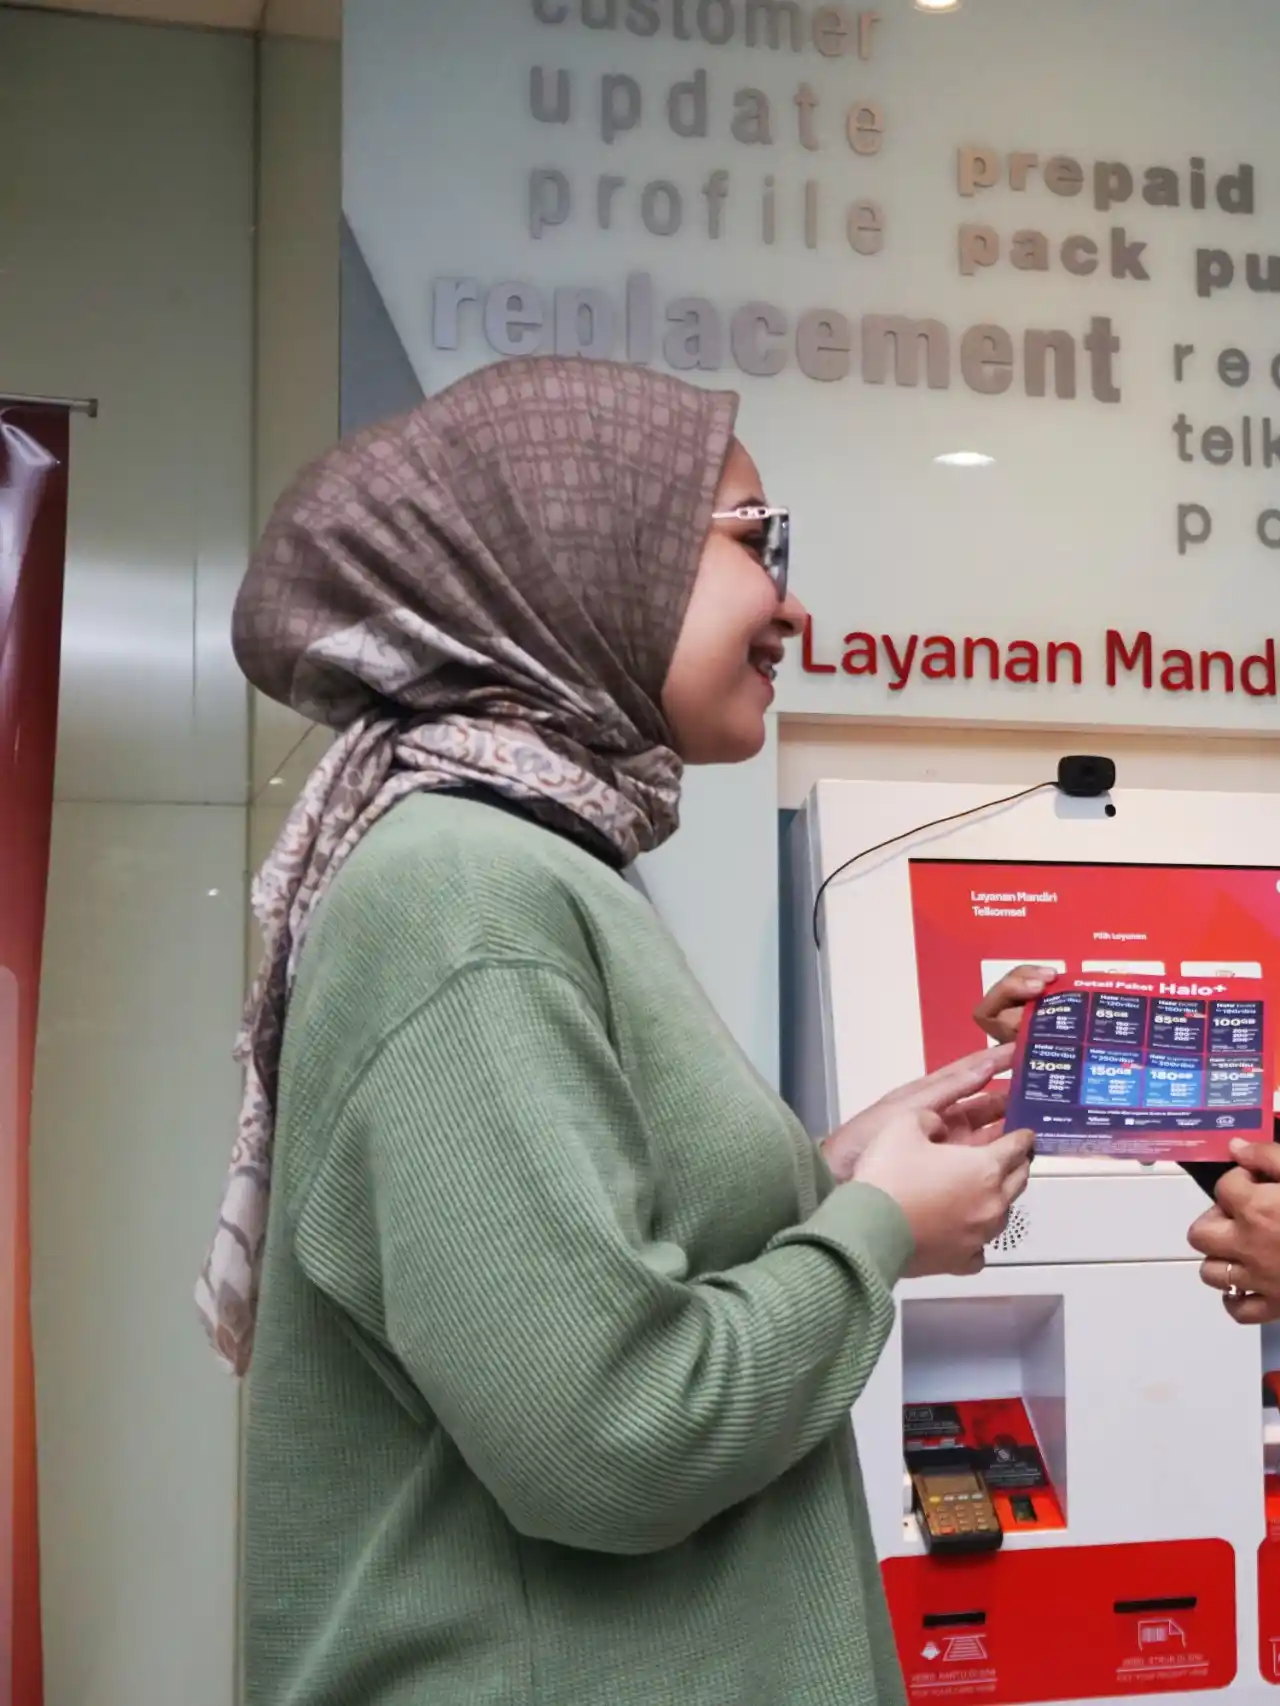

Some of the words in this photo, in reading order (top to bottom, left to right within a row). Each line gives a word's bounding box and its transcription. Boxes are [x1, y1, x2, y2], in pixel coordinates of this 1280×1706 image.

[529, 65, 885, 156] update
[528, 166, 887, 256] profile
[956, 145, 1255, 214] prepaid
[957, 222, 1149, 281] pack
[431, 271, 1122, 403] replacement
[802, 614, 1083, 692] Layanan
[971, 890, 1016, 903] Layanan
[1017, 891, 1058, 903] Mandiri
[972, 905, 1027, 918] Telkomsel
[1159, 982, 1228, 996] Halo+
